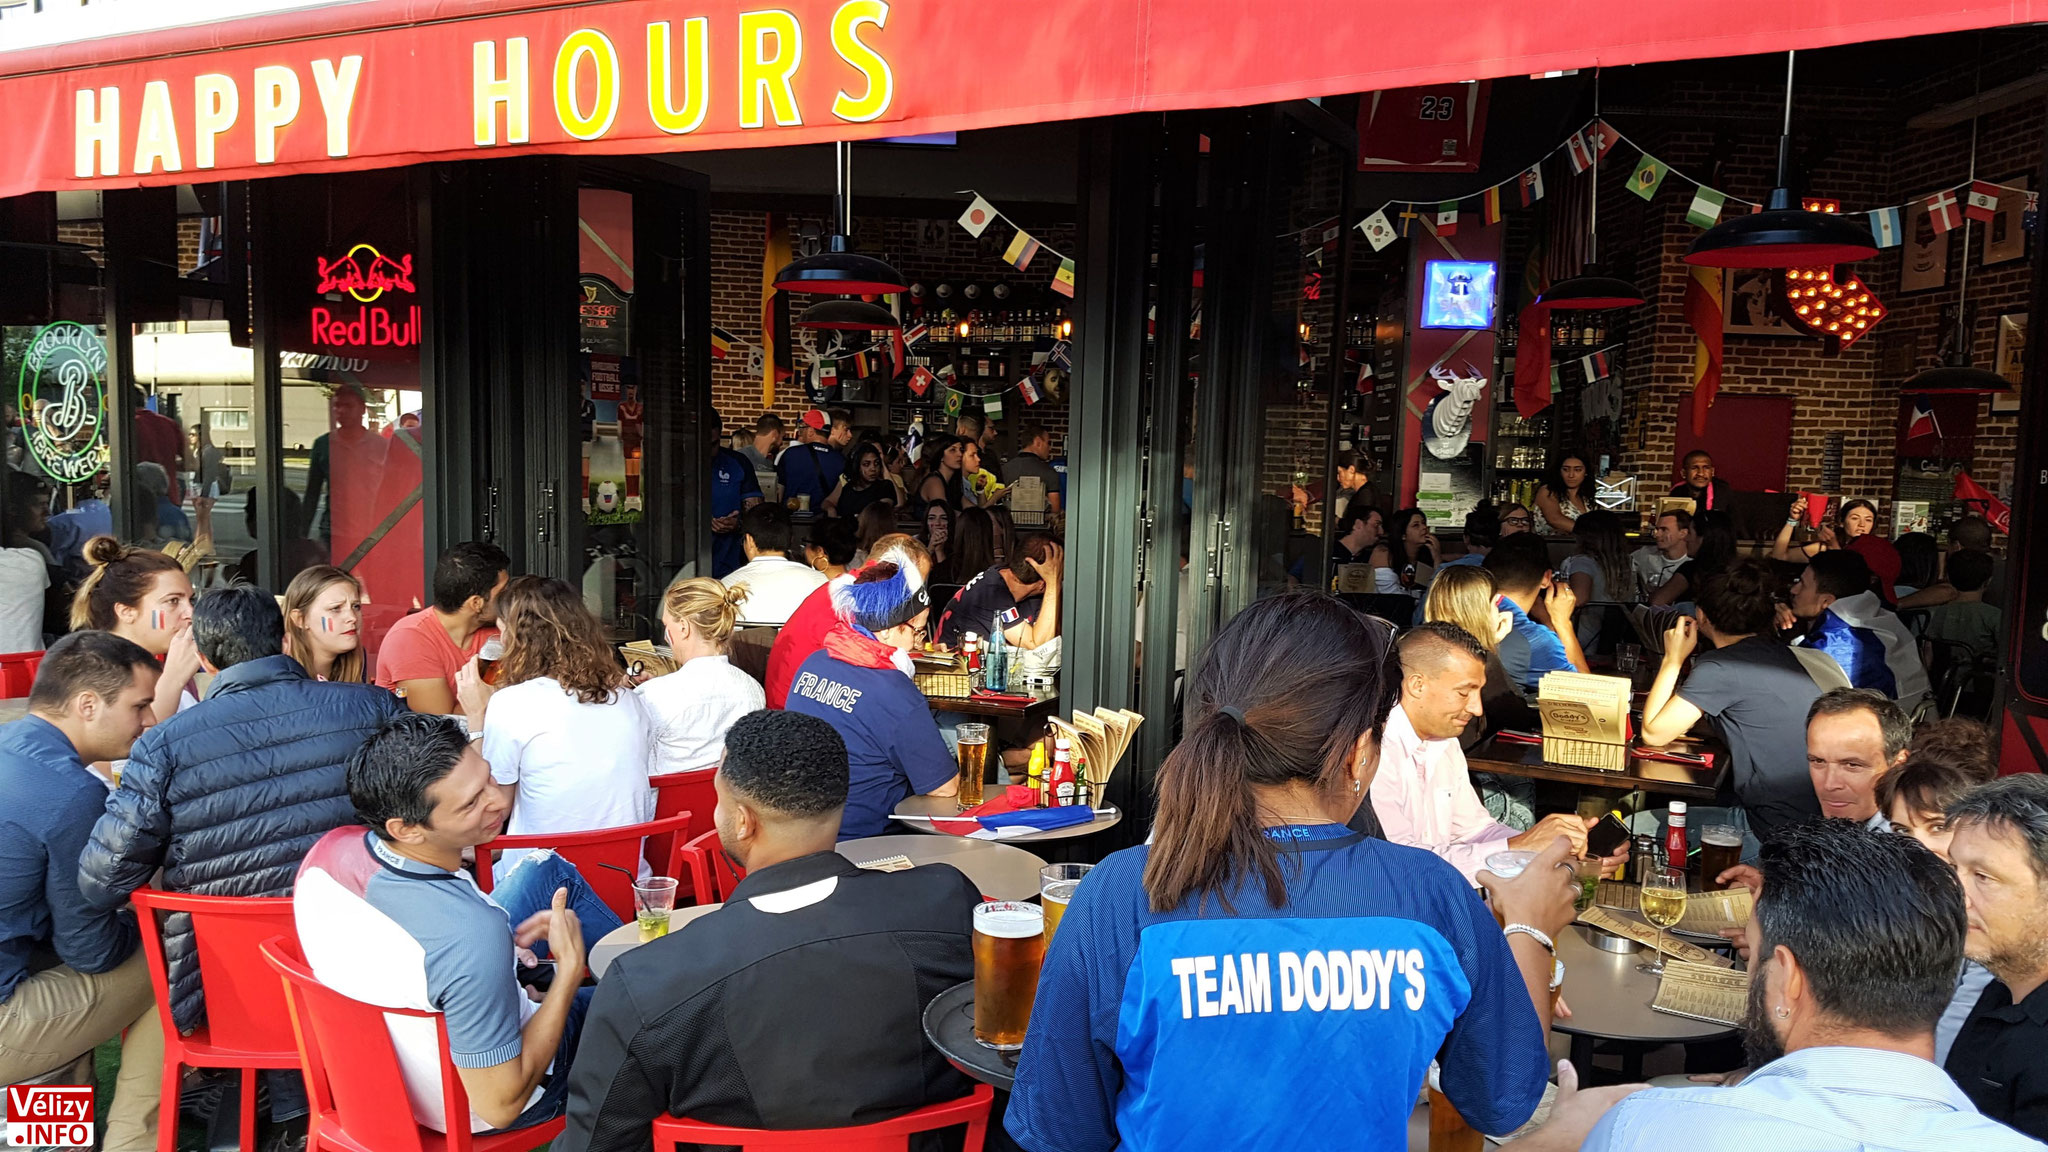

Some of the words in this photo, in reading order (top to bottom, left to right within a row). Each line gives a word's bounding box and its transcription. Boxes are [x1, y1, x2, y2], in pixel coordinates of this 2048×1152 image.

[75, 55, 363, 178] HAPPY
[473, 0, 894, 146] HOURS
[1419, 96, 1454, 120] 23
[312, 306, 366, 346] Red
[580, 304, 617, 317] ESSERT
[27, 325, 107, 373] BROOKLYN
[31, 434, 105, 479] BREWERY
[793, 671, 863, 714] FRANCE
[1171, 952, 1273, 1020] TEAM
[1278, 948, 1426, 1013] DODDY'S
